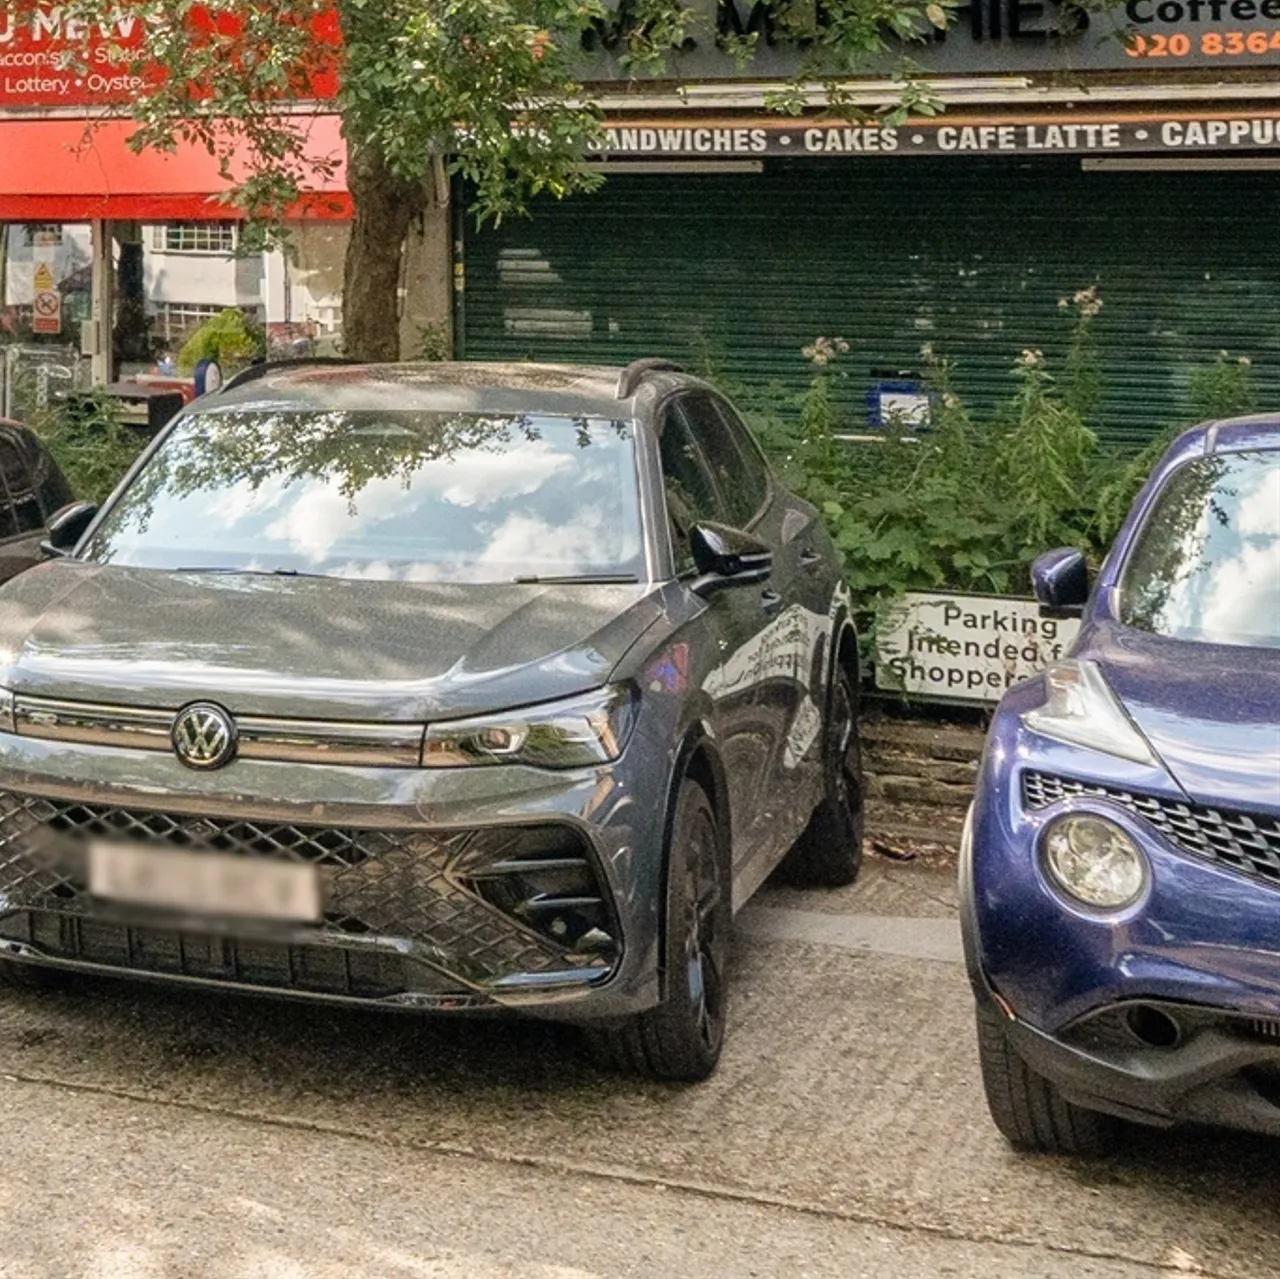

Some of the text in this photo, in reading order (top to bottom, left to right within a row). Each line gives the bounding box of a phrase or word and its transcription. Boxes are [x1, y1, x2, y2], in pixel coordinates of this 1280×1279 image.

[5, 76, 70, 96] Lottery
[87, 73, 147, 95] Oyste
[587, 120, 1280, 151] SANDWICHES CAKES CAFE LATTE CAPPU
[944, 606, 1058, 640] Parking
[908, 630, 1038, 662] Intended
